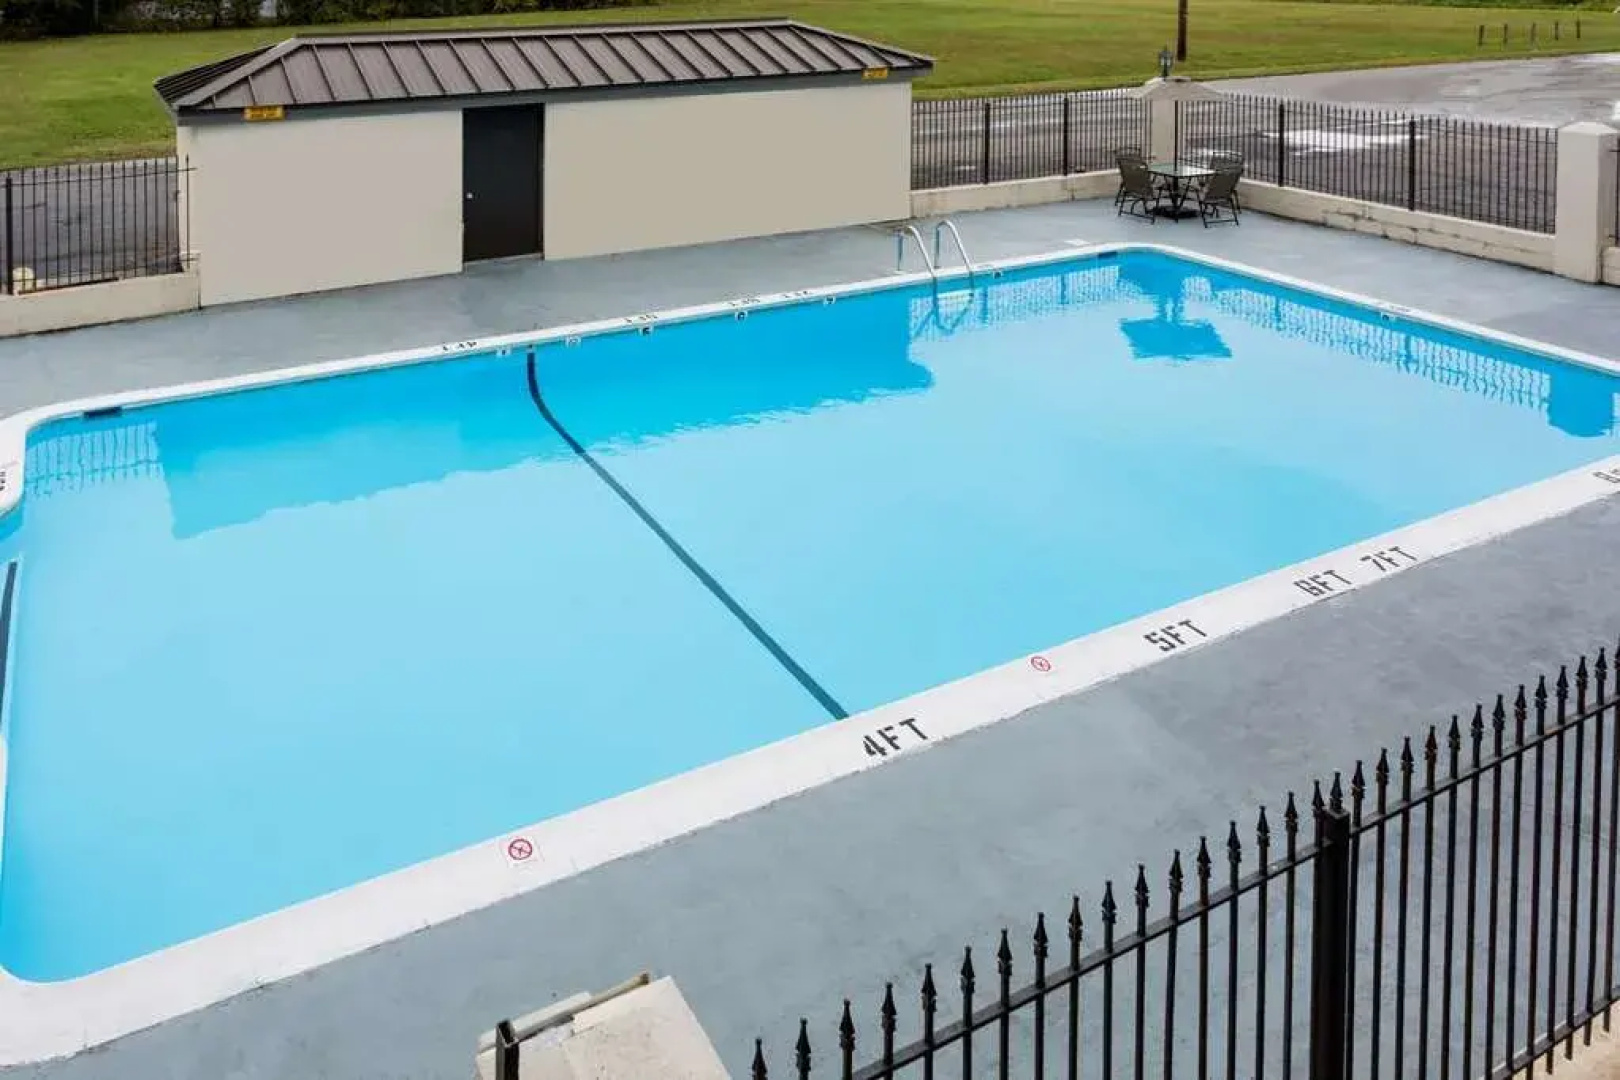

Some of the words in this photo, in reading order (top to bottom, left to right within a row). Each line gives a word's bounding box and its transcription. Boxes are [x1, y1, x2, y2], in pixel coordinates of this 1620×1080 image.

[1360, 546, 1417, 572] 7FT
[1143, 619, 1208, 652] 5FT
[863, 717, 928, 756] 4FT
